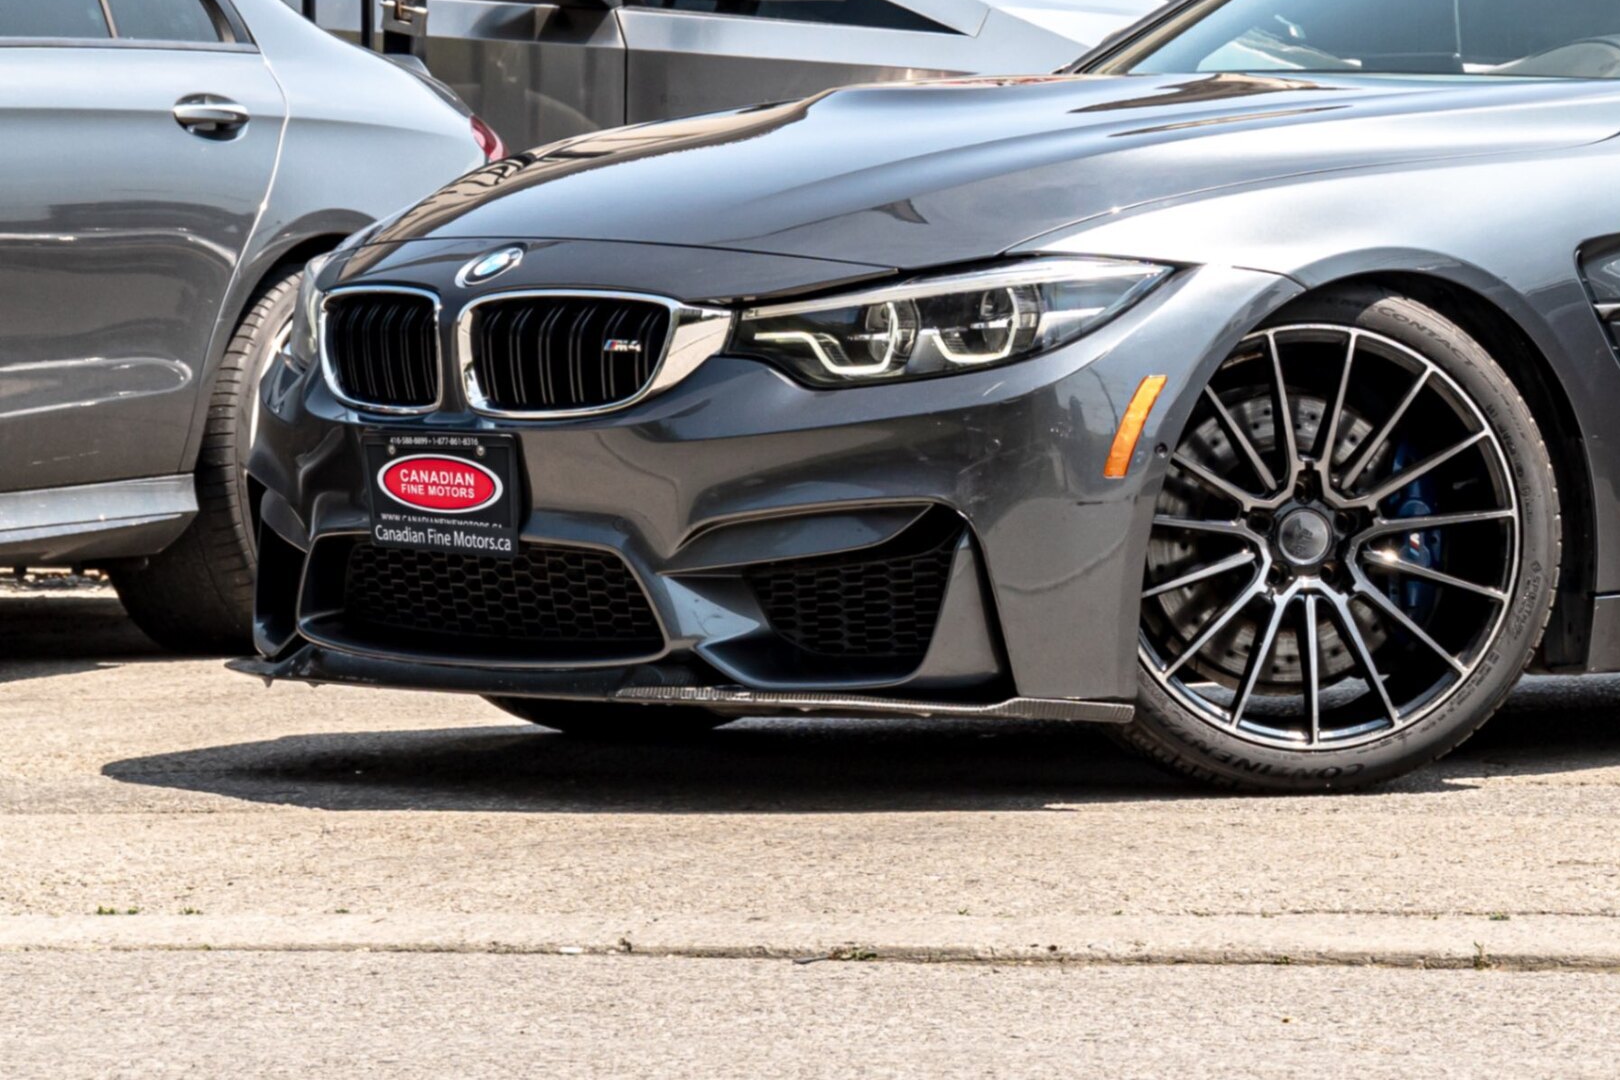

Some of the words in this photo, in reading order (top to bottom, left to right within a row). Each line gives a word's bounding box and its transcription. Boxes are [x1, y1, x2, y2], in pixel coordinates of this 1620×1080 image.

[400, 469, 475, 486] CANADIAN
[401, 483, 425, 495] FINE
[428, 485, 475, 499] MOTORS
[375, 524, 425, 543] Canadian
[427, 528, 451, 546] Fine
[453, 531, 512, 551] Motors.ca
